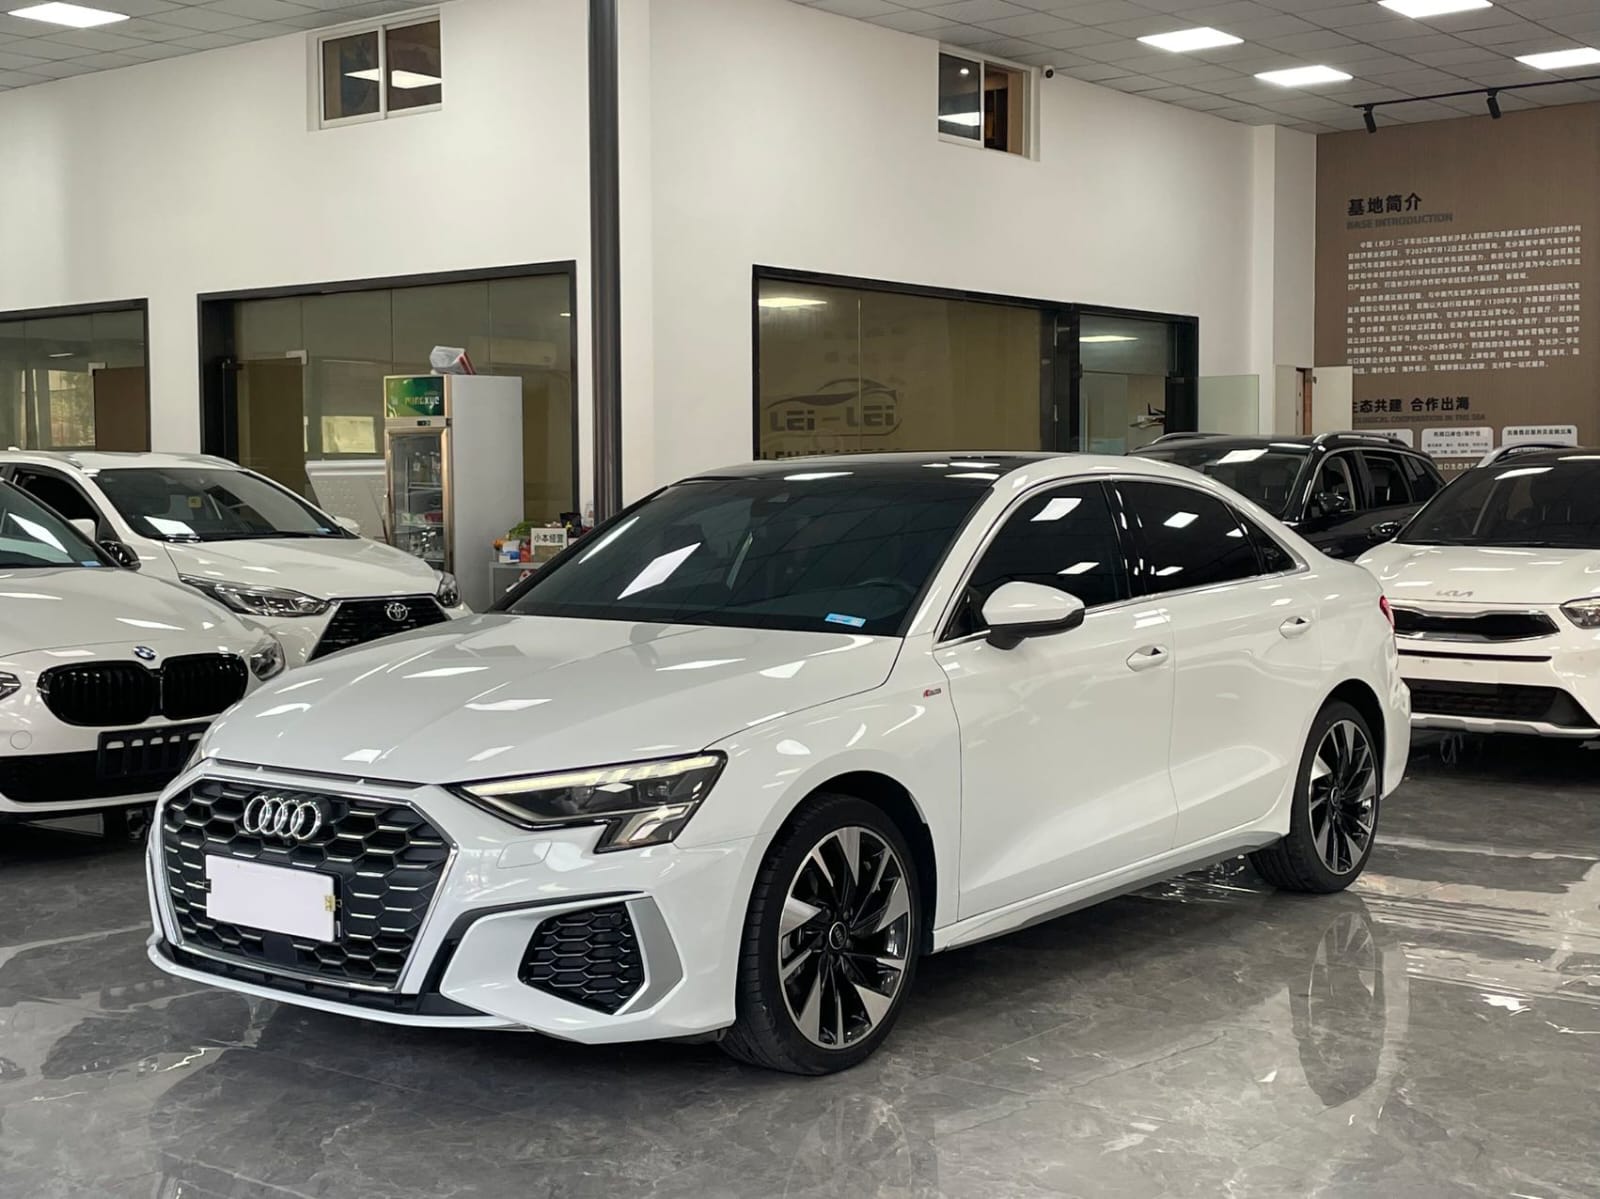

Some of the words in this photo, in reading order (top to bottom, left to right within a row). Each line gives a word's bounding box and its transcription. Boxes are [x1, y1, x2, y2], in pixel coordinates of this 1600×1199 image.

[1347, 192, 1423, 216] 基地简介
[1410, 396, 1470, 411] 合作出海
